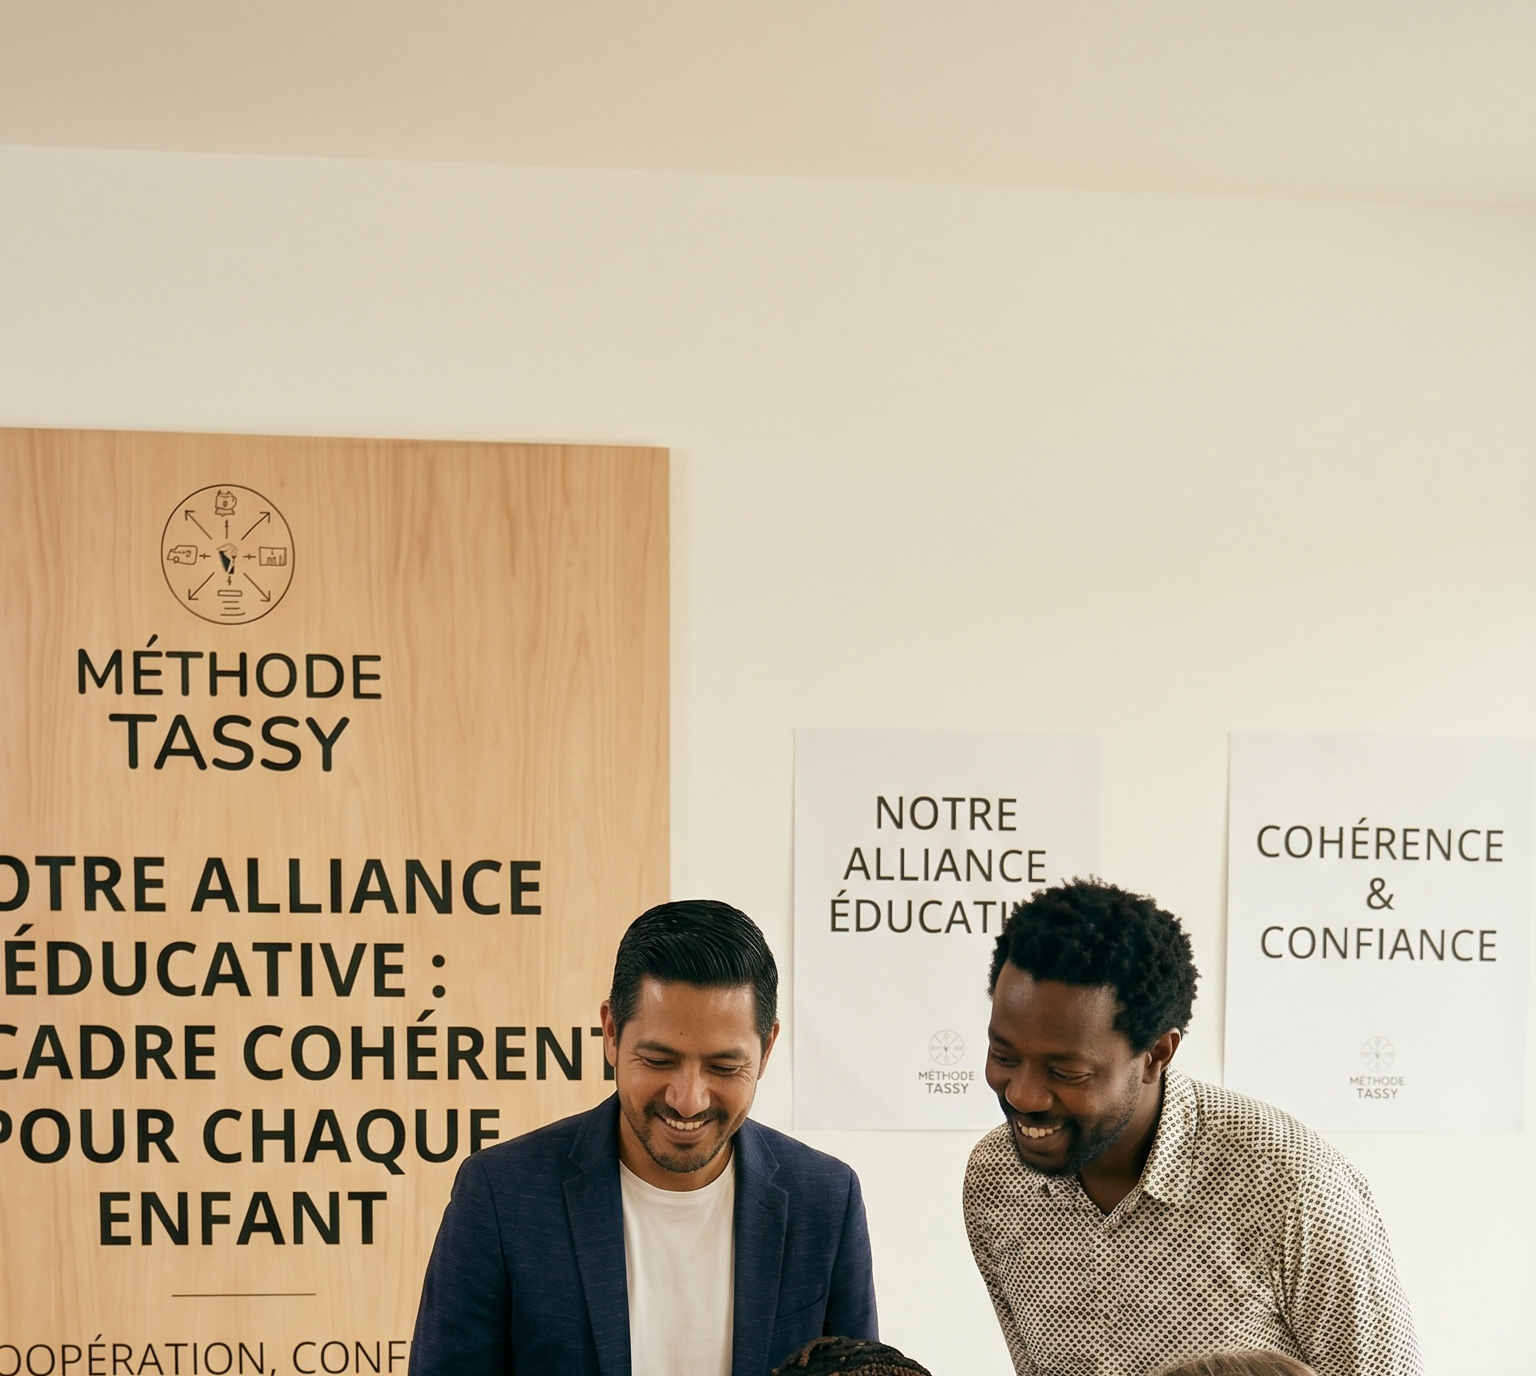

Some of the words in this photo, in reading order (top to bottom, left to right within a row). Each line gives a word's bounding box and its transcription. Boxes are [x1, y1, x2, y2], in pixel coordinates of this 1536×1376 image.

[78, 634, 382, 700] MÉTHODE
[109, 714, 350, 772] TASSY
[878, 796, 1017, 832] NOTRE
[1256, 817, 1504, 863] COHÉRENCE
[843, 847, 1046, 883] ALLIANCE
[191, 858, 542, 916] ALLIANCE
[1366, 877, 1395, 910] &
[830, 890, 1019, 934] ÉDUCATI
[4, 924, 406, 998] ÉDUCATIVE
[431, 954, 446, 999] :
[1260, 925, 1498, 962] CONFIANCE
[918, 1068, 974, 1081] MÉTHODE
[925, 1082, 969, 1094] TASSY
[1349, 1075, 1405, 1086] MÉTHODE
[1356, 1088, 1398, 1099] TASSY
[100, 1191, 388, 1246] ENFANT
[292, 1341, 413, 1375] CONF
